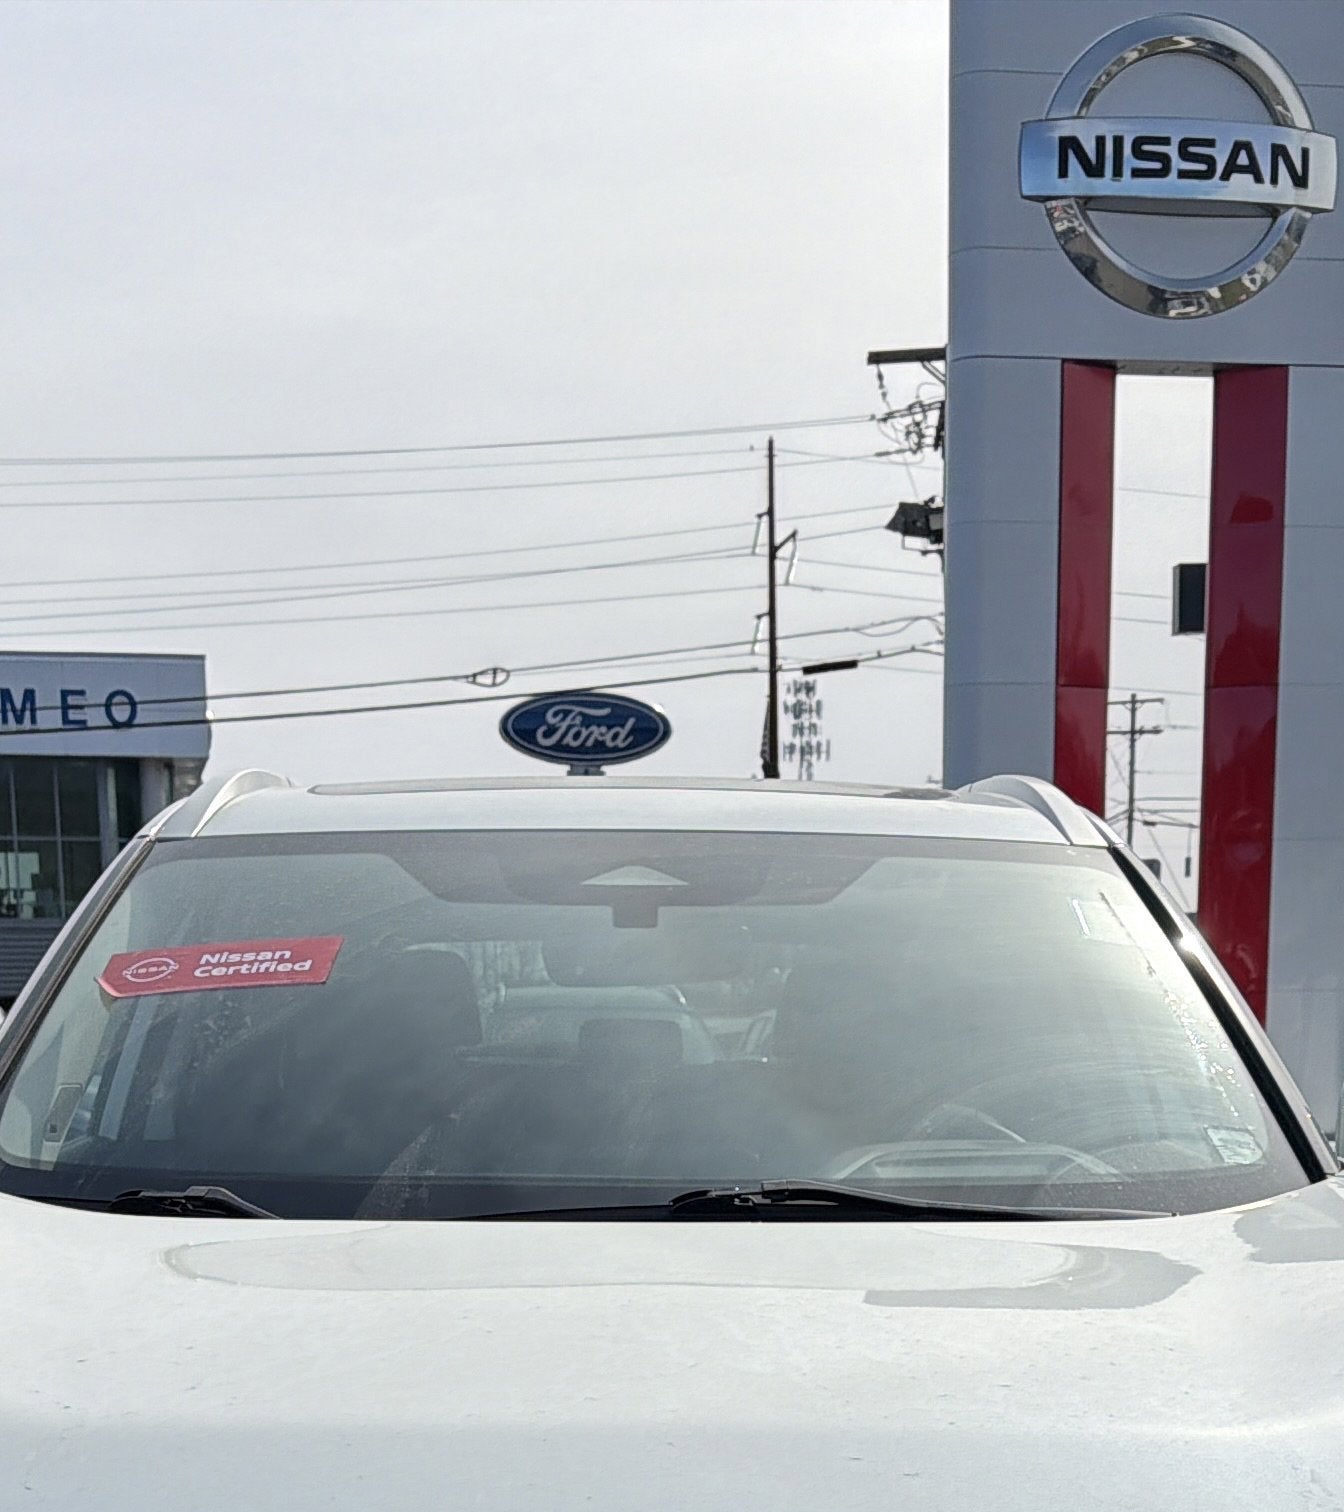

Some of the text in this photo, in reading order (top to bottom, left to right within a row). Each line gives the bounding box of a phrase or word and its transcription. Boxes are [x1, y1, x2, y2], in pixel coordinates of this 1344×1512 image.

[1058, 134, 1309, 189] NISSAN
[536, 704, 637, 748] Ford
[199, 949, 292, 965] Nissan
[122, 961, 179, 977] NISSAN
[193, 959, 313, 979] Certified
